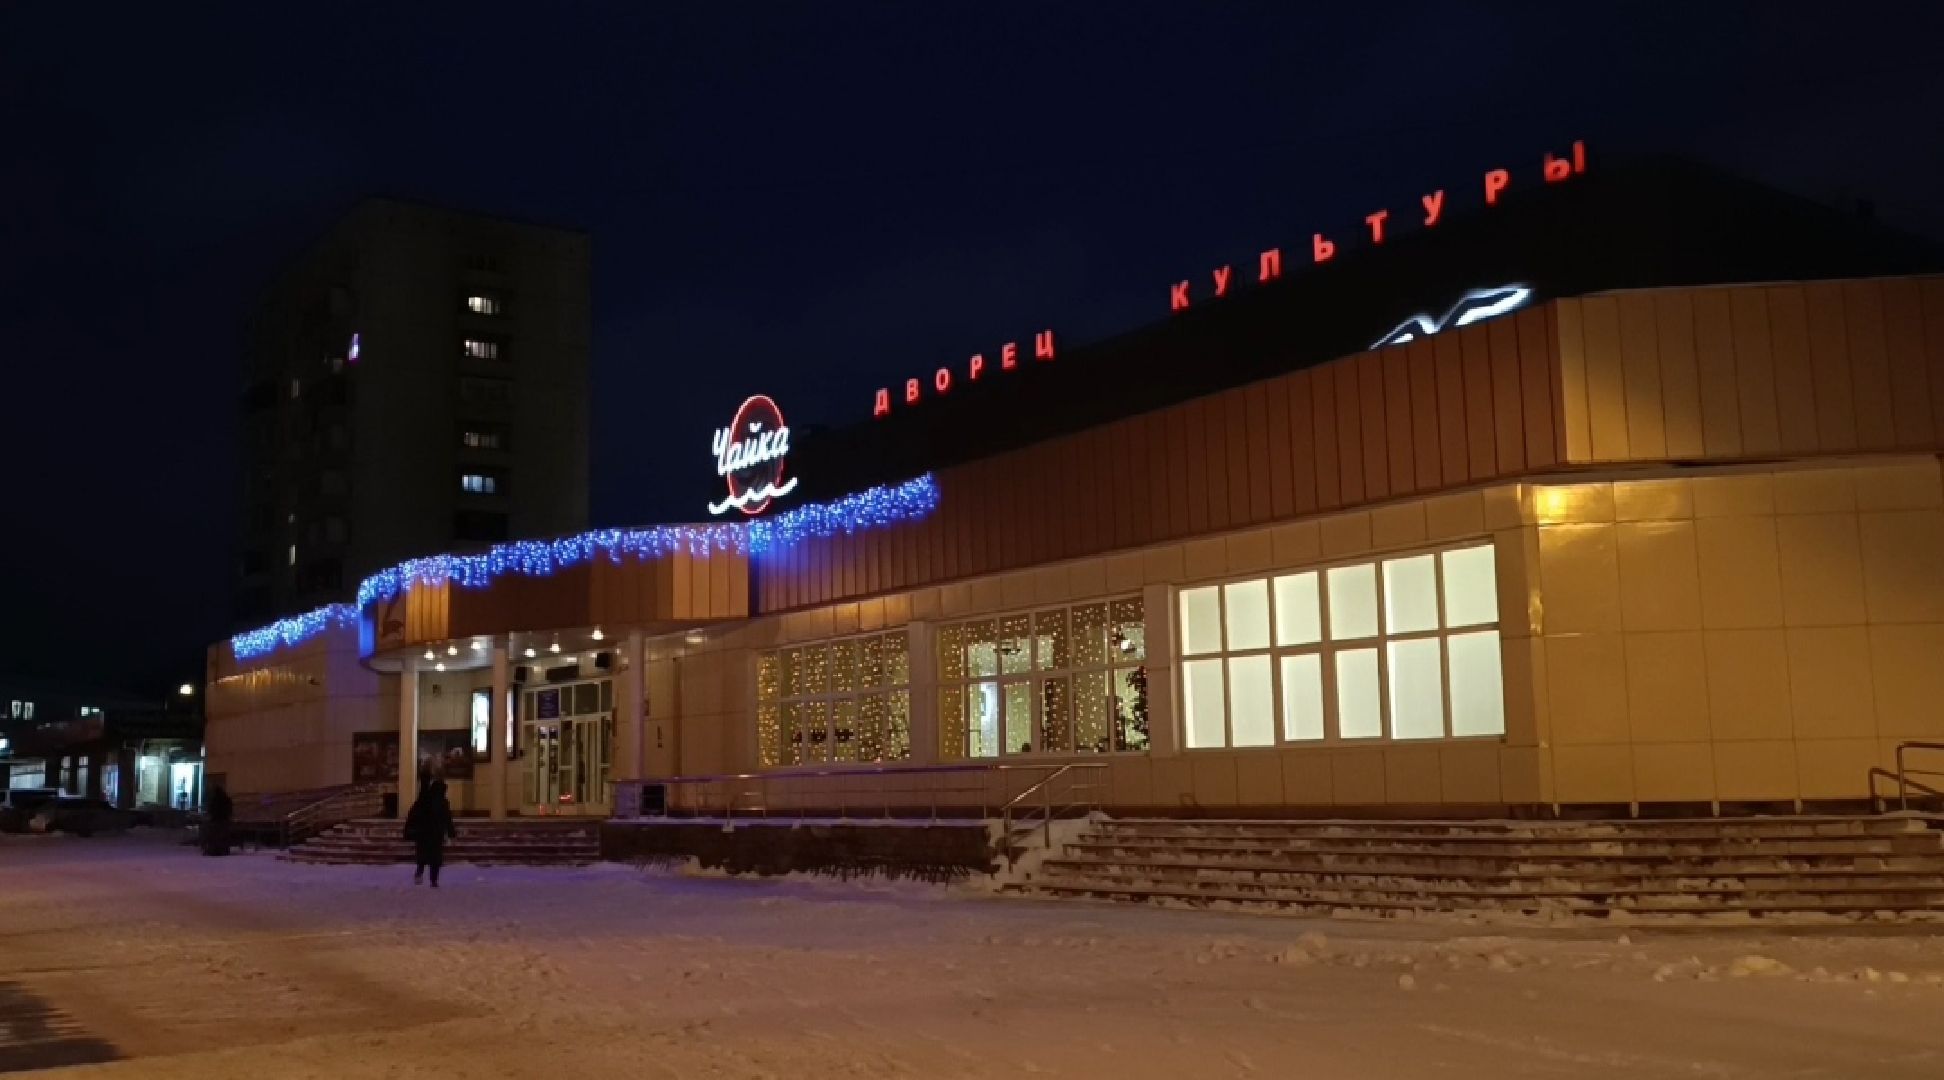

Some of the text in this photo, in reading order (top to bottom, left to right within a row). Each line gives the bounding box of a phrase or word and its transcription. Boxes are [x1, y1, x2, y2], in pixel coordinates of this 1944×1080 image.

[873, 141, 1586, 416] ДВОРЕЦ КУЛЬТУРЫ
[711, 422, 790, 476] Чайка
